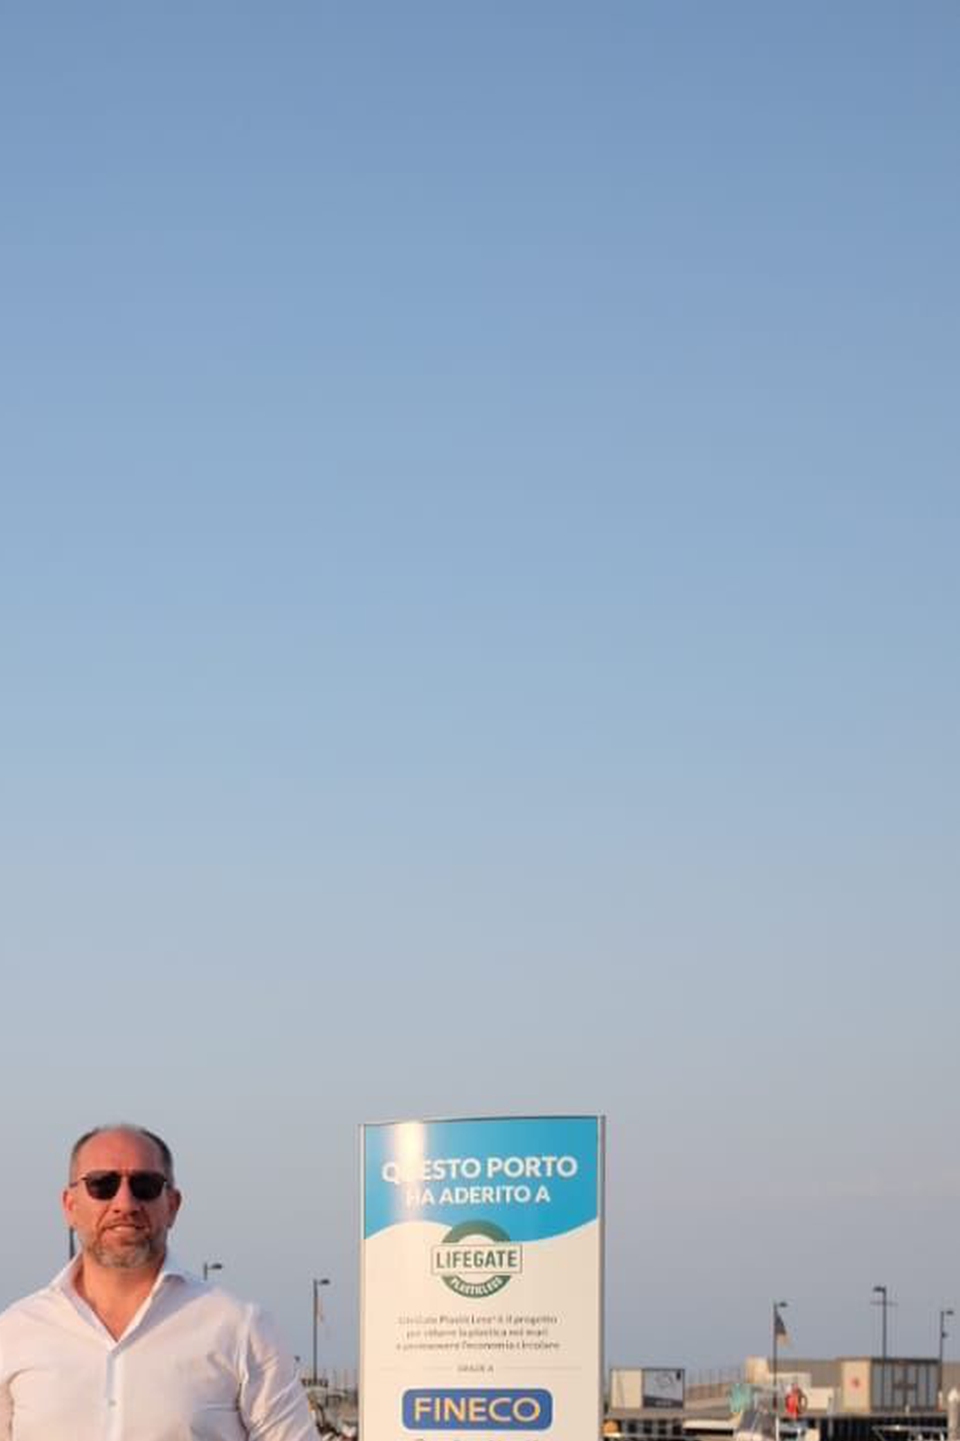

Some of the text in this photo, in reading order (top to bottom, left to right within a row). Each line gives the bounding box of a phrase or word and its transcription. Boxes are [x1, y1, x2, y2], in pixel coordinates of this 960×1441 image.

[381, 1156, 579, 1185] QESTO PORTO
[439, 1185, 531, 1205] ADERITO
[535, 1186, 551, 1203] A
[436, 1250, 518, 1269] LIFEGATE
[413, 1396, 541, 1422] FINECO
